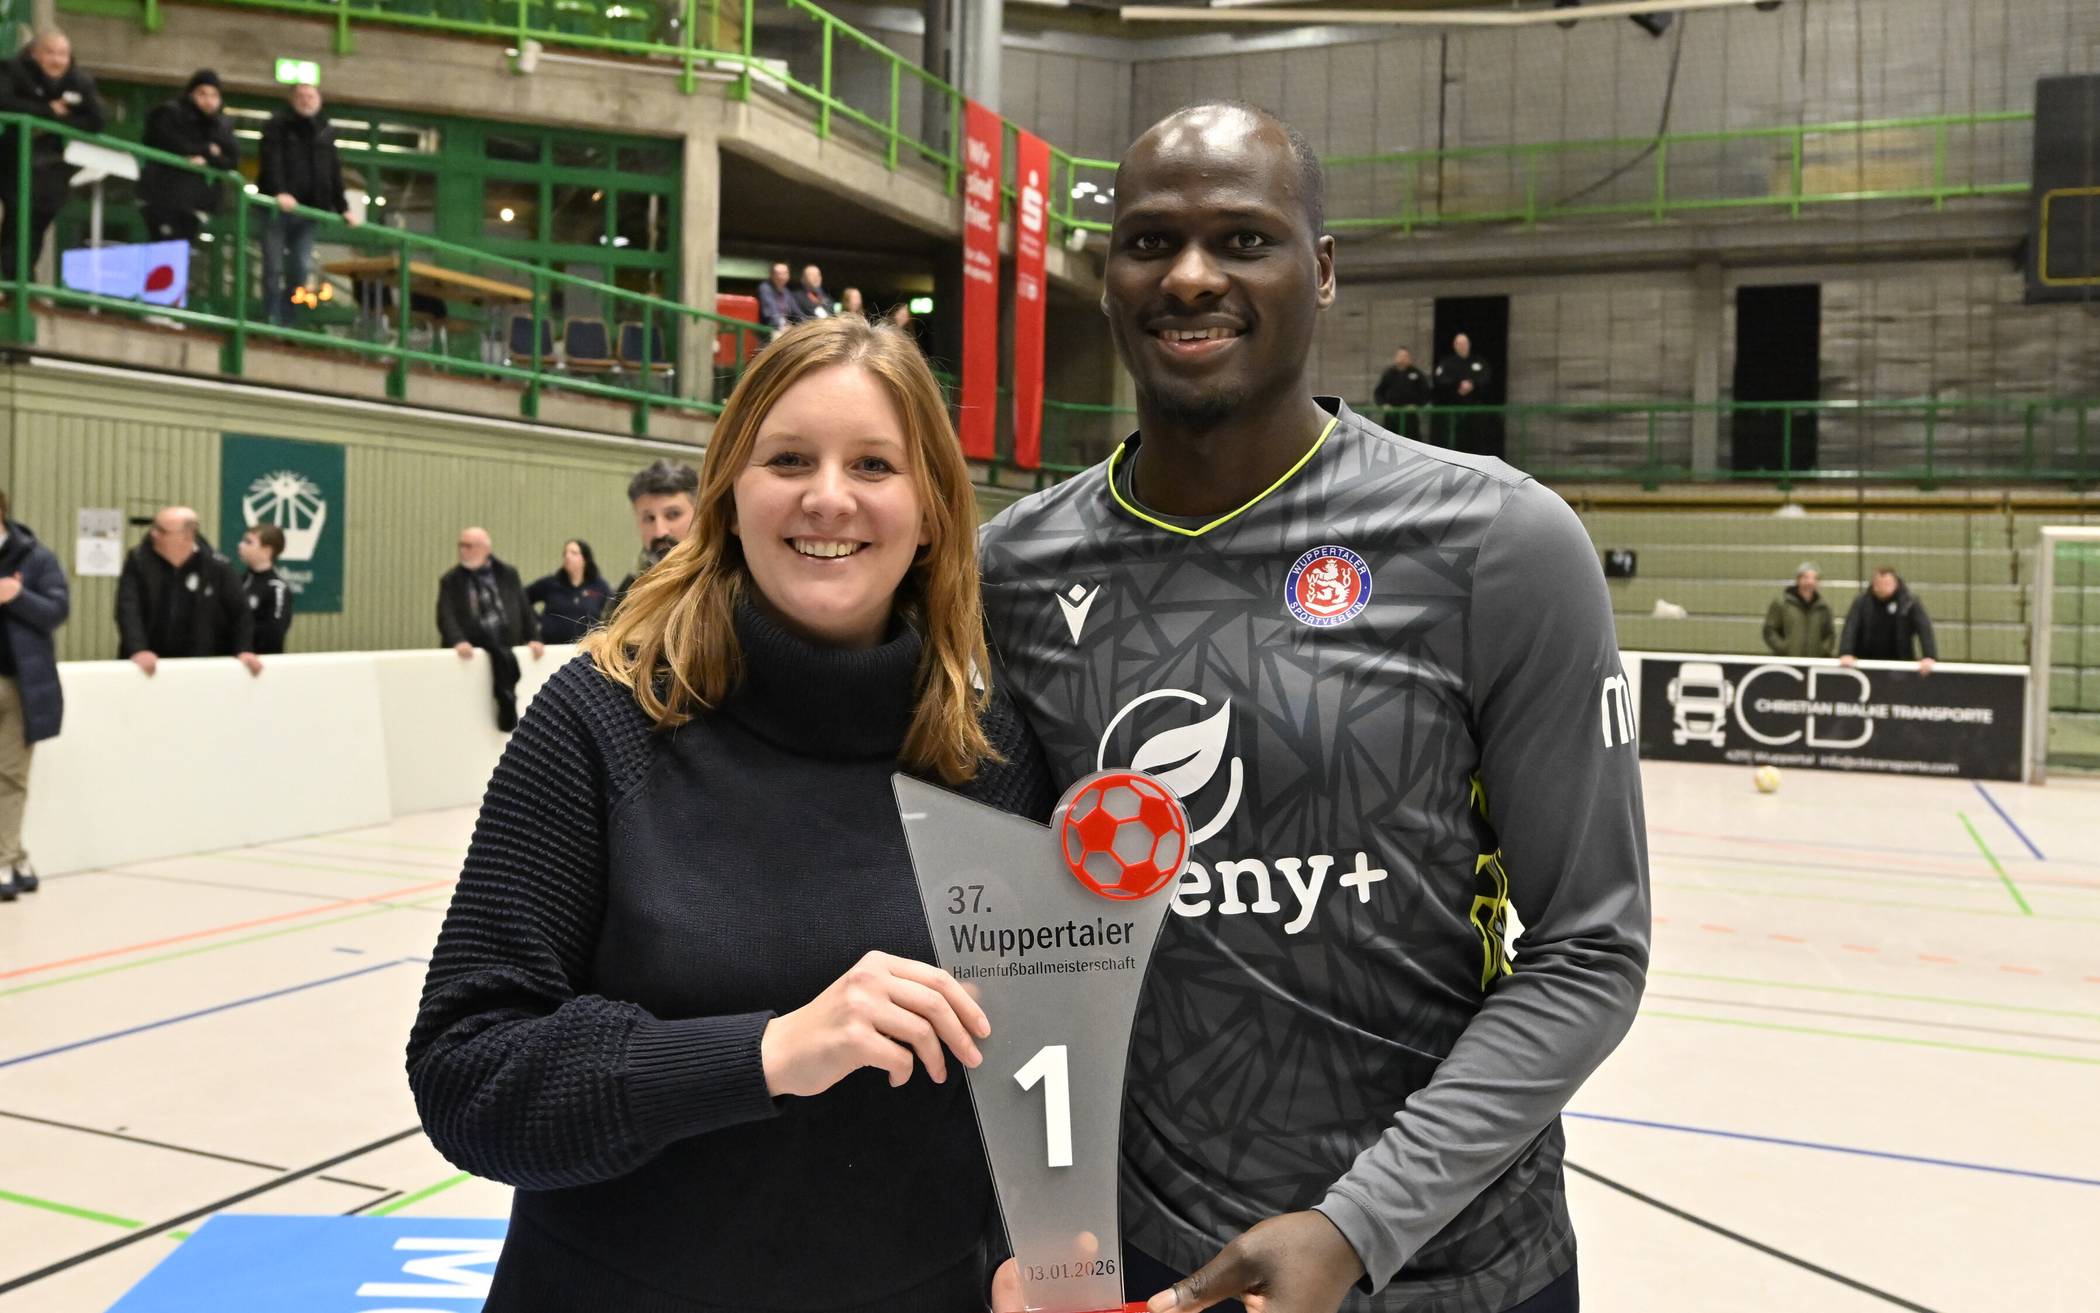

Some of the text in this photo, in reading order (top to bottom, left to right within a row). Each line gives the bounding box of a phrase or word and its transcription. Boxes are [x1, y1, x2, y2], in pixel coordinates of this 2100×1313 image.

[1292, 548, 1367, 575] WUPPERTALER
[1290, 601, 1364, 625] SPORTVEREIN
[1734, 664, 1873, 749] CB
[1754, 698, 1832, 715] CHRISTIAN
[1892, 704, 1994, 724] TRANSPORTE
[947, 884, 992, 915] 37.
[950, 917, 1134, 957] Wuppertaler
[953, 956, 1136, 979] Hallenfußballmeisterschaft
[1013, 1045, 1073, 1167] 1
